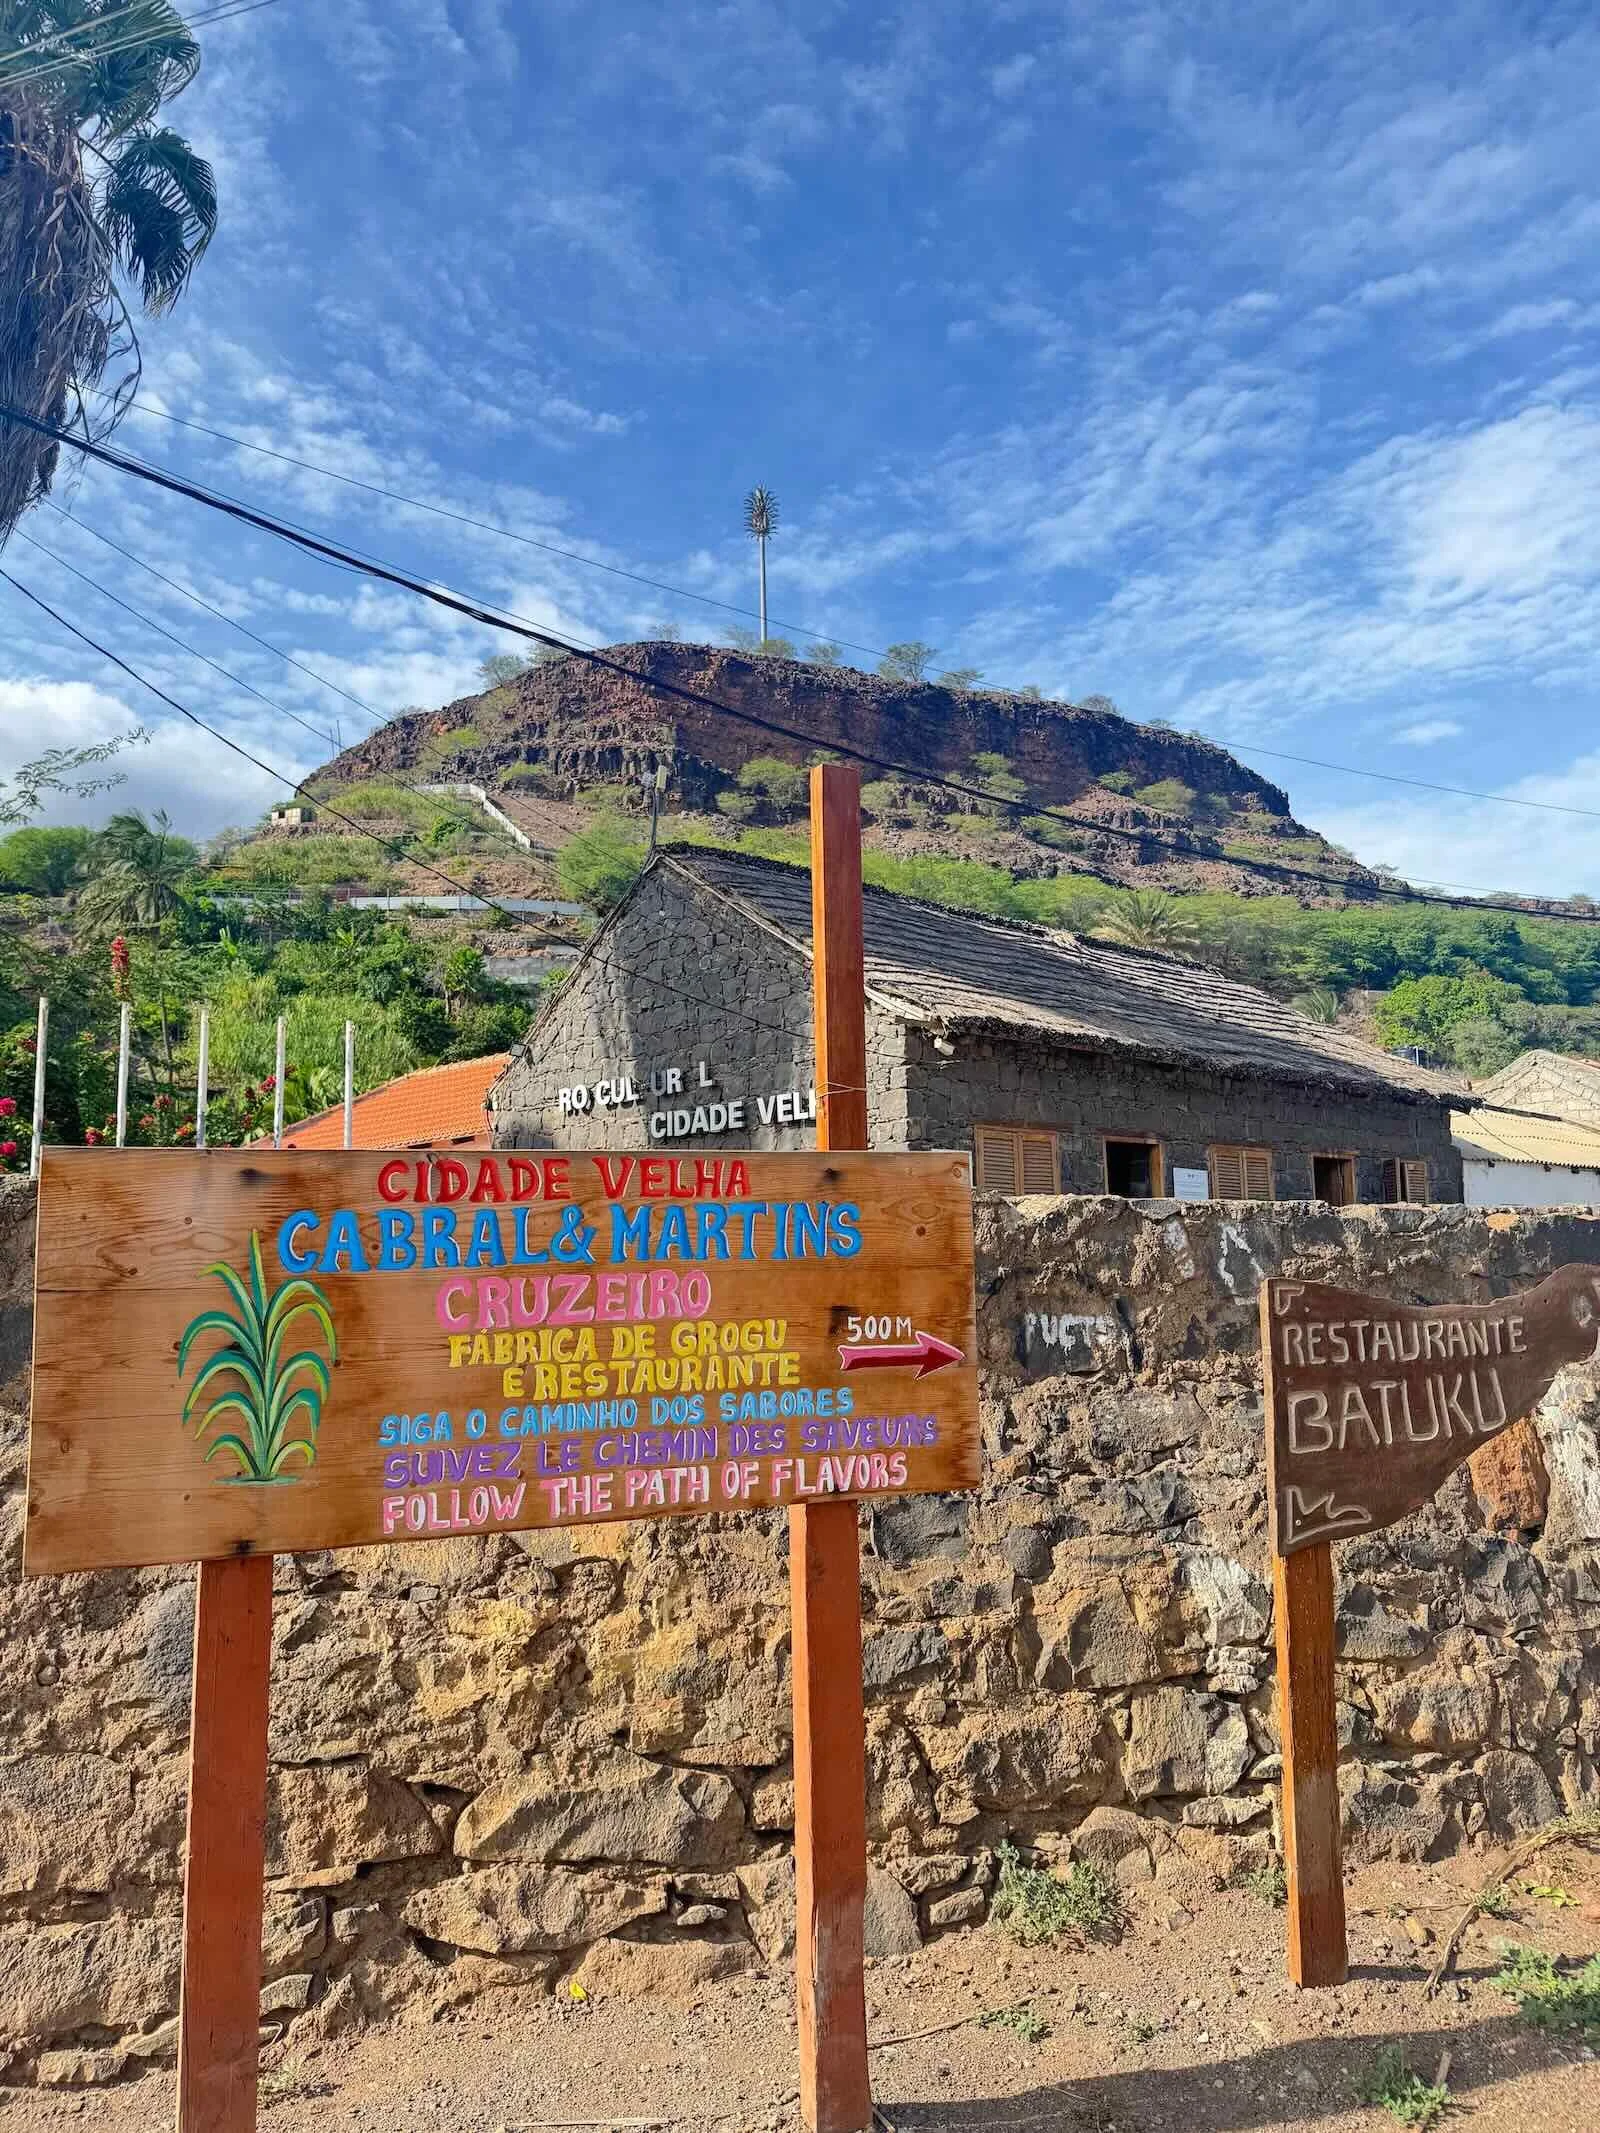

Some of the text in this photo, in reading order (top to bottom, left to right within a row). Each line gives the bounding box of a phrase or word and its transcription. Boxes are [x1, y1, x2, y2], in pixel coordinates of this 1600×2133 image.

[651, 1088, 817, 1138] CIDADE VEL
[377, 1156, 751, 1202] CIDADE VELHA
[609, 1201, 863, 1264] MARTINS
[436, 1268, 712, 1332] CRUZEIRO
[448, 1319, 788, 1368] FÁBRICA DE GROGU
[1282, 1316, 1527, 1366] RESTAURANTE
[533, 1351, 801, 1401] RESTAURANTE
[379, 1386, 855, 1448] SIGA O CAMINHO DOS SABORES
[1287, 1367, 1507, 1455] BATUKU
[384, 1415, 939, 1489] SUIVEZ LE CHEMIN DES SAVEURS
[382, 1452, 908, 1534] FOLLOW THE PATH OF FLAVORS
